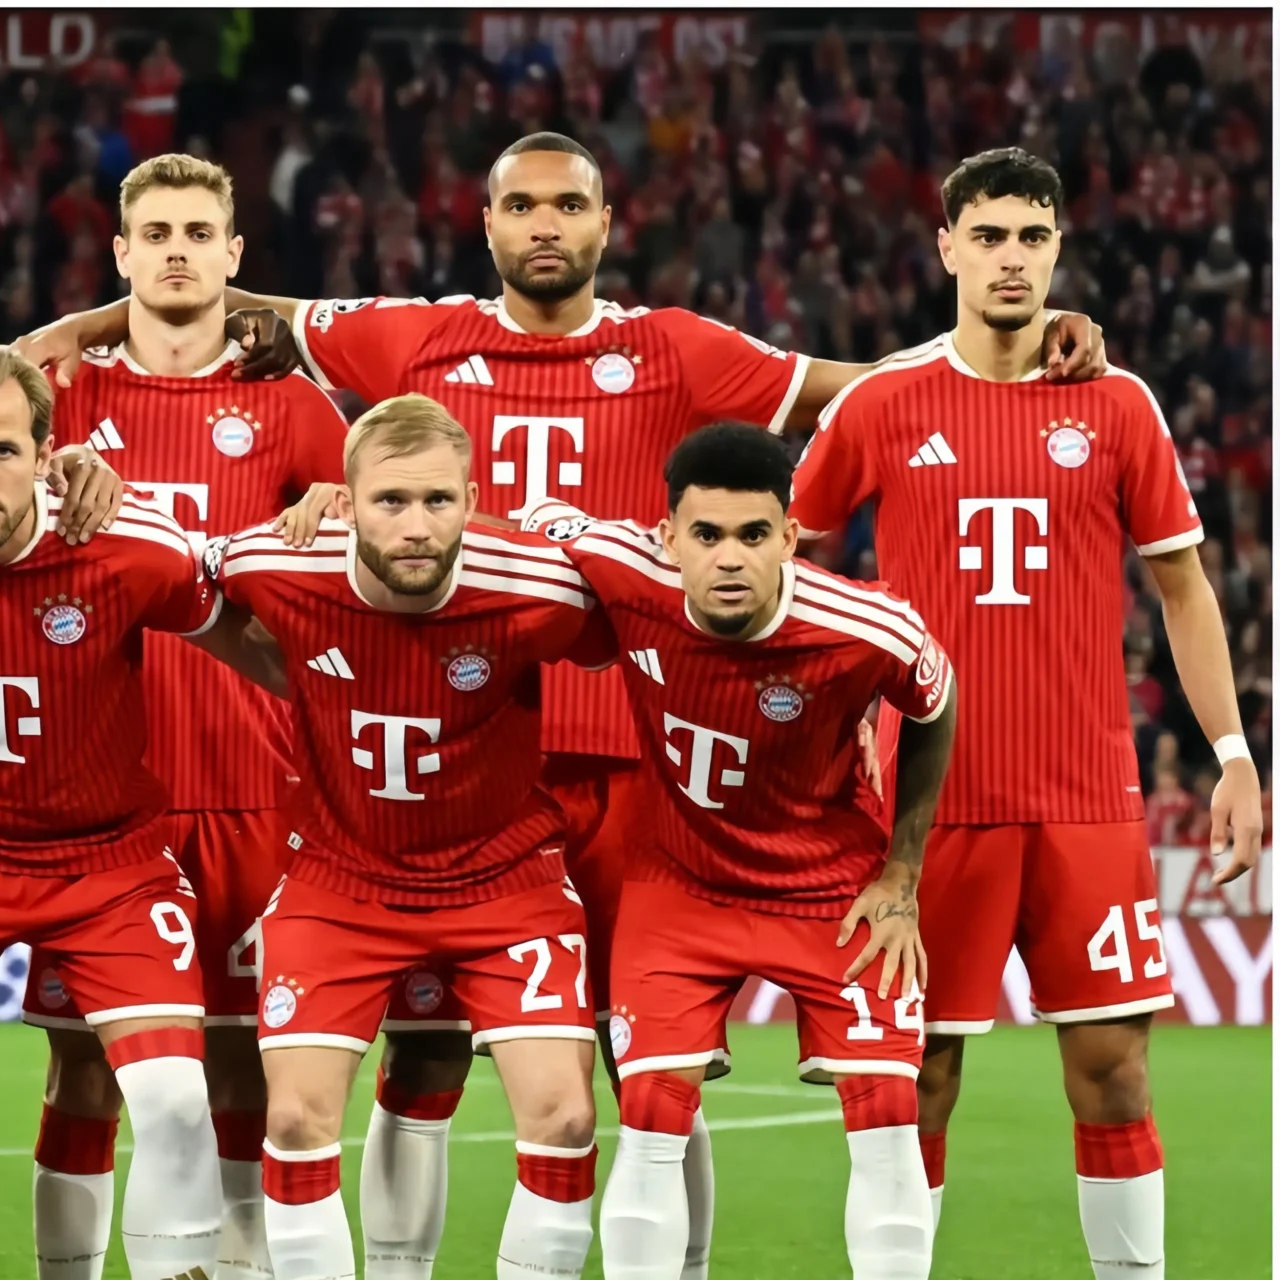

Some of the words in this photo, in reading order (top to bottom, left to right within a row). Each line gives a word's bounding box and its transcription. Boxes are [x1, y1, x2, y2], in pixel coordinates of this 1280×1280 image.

[492, 415, 583, 519] T
[958, 498, 1047, 604] T
[351, 710, 441, 800] T
[664, 712, 749, 808] T
[150, 902, 195, 971] 9
[508, 934, 587, 1011] 27
[1087, 898, 1166, 982] 45
[839, 976, 926, 1047] 14
